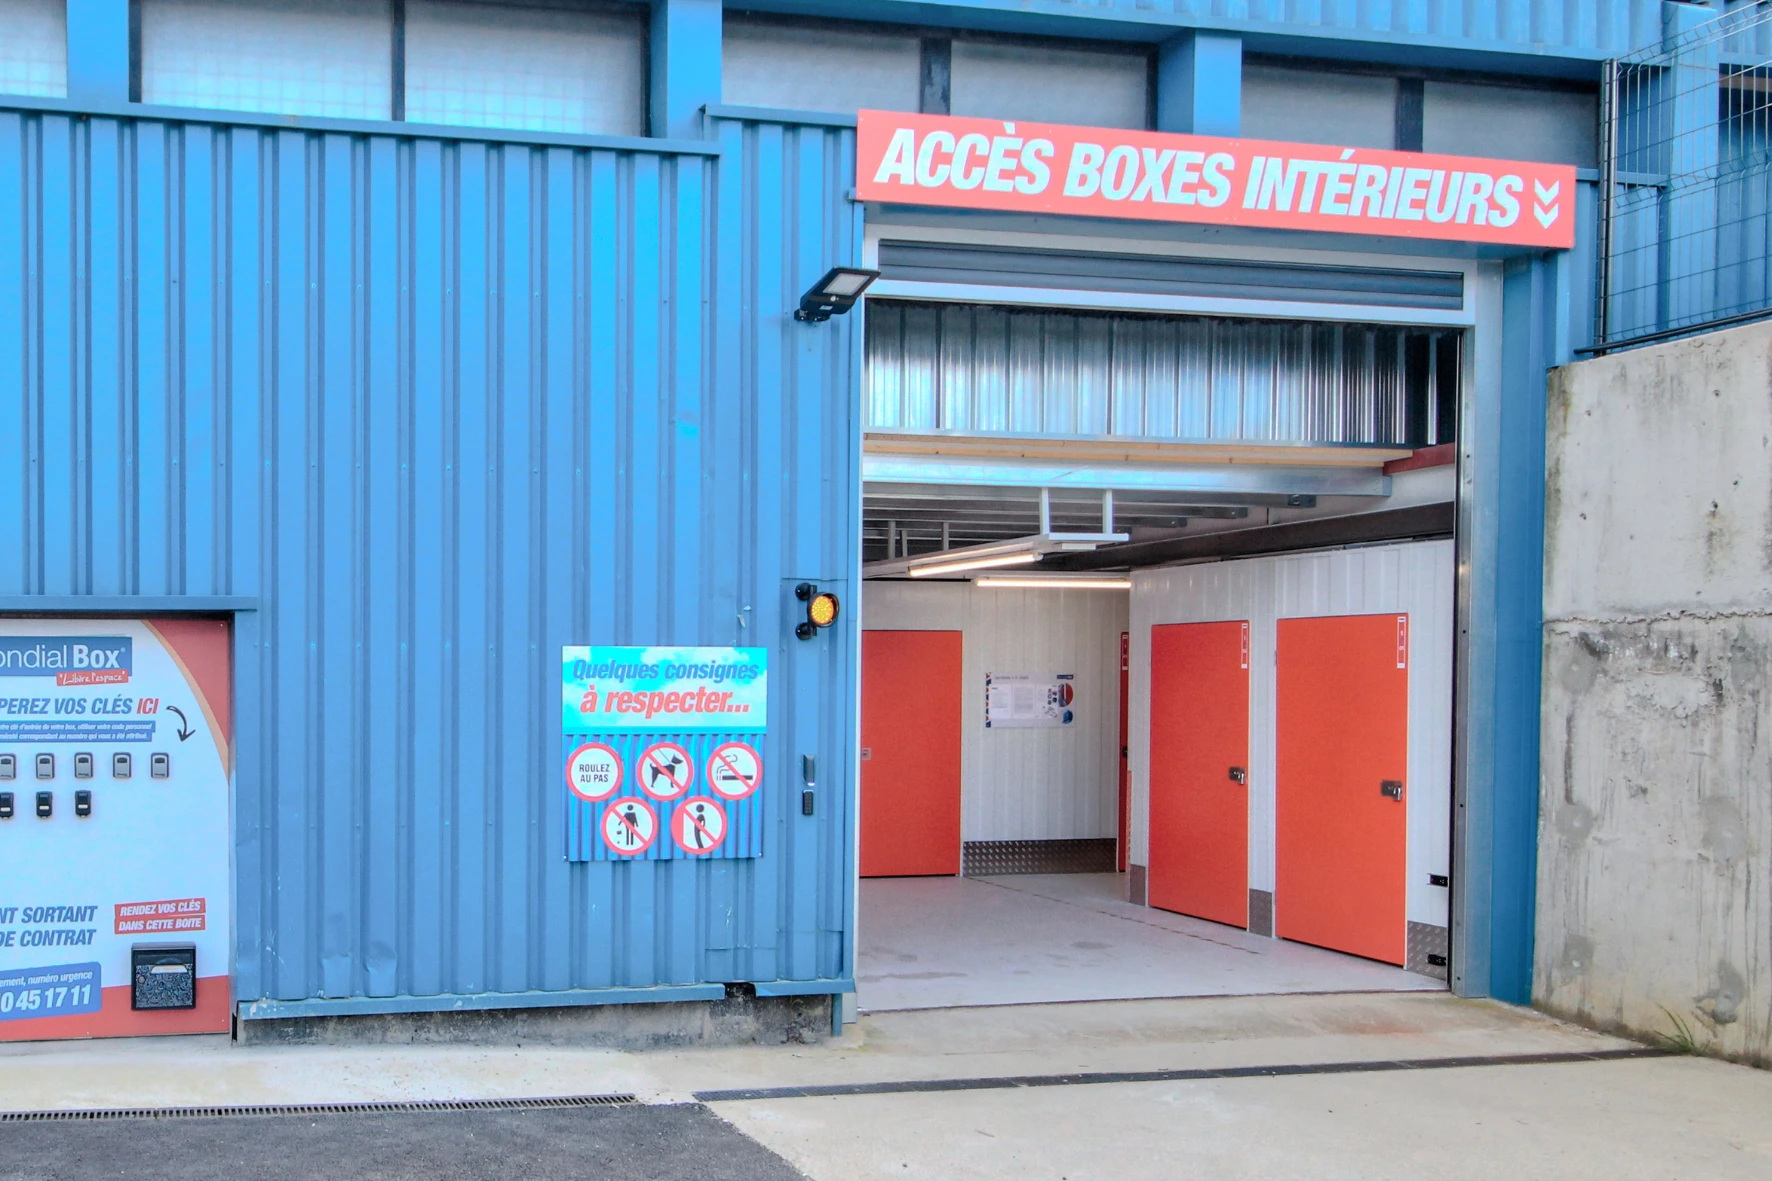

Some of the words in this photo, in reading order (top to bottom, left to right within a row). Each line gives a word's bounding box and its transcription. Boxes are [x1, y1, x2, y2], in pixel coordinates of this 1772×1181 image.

[873, 122, 1055, 195] ACCÈS
[1062, 141, 1236, 208] BOXES
[1242, 148, 1524, 228] INTÉRIEURS
[73, 644, 120, 669] Box
[573, 659, 660, 683] Quelques
[664, 660, 759, 684] consignes
[54, 697, 88, 715] VOS
[91, 693, 133, 715] CLÉS
[136, 698, 160, 714] ICI
[580, 684, 598, 713] à
[604, 686, 750, 719] respecter...
[579, 763, 610, 773] ROULEZ
[580, 774, 592, 783] AU
[593, 774, 609, 783] PAS
[21, 905, 98, 924] SORTANT
[120, 904, 156, 917] RENDEZ
[157, 902, 176, 914] VOS
[177, 899, 201, 913] CLÉS
[118, 920, 144, 932] DANS
[146, 919, 174, 931] CETTE
[20, 928, 97, 947] CONTRAT
[28, 973, 59, 985] numéro
[60, 971, 93, 983] urgence
[15, 989, 41, 1011] 45
[45, 986, 68, 1009] 17
[71, 984, 91, 1006] 11
